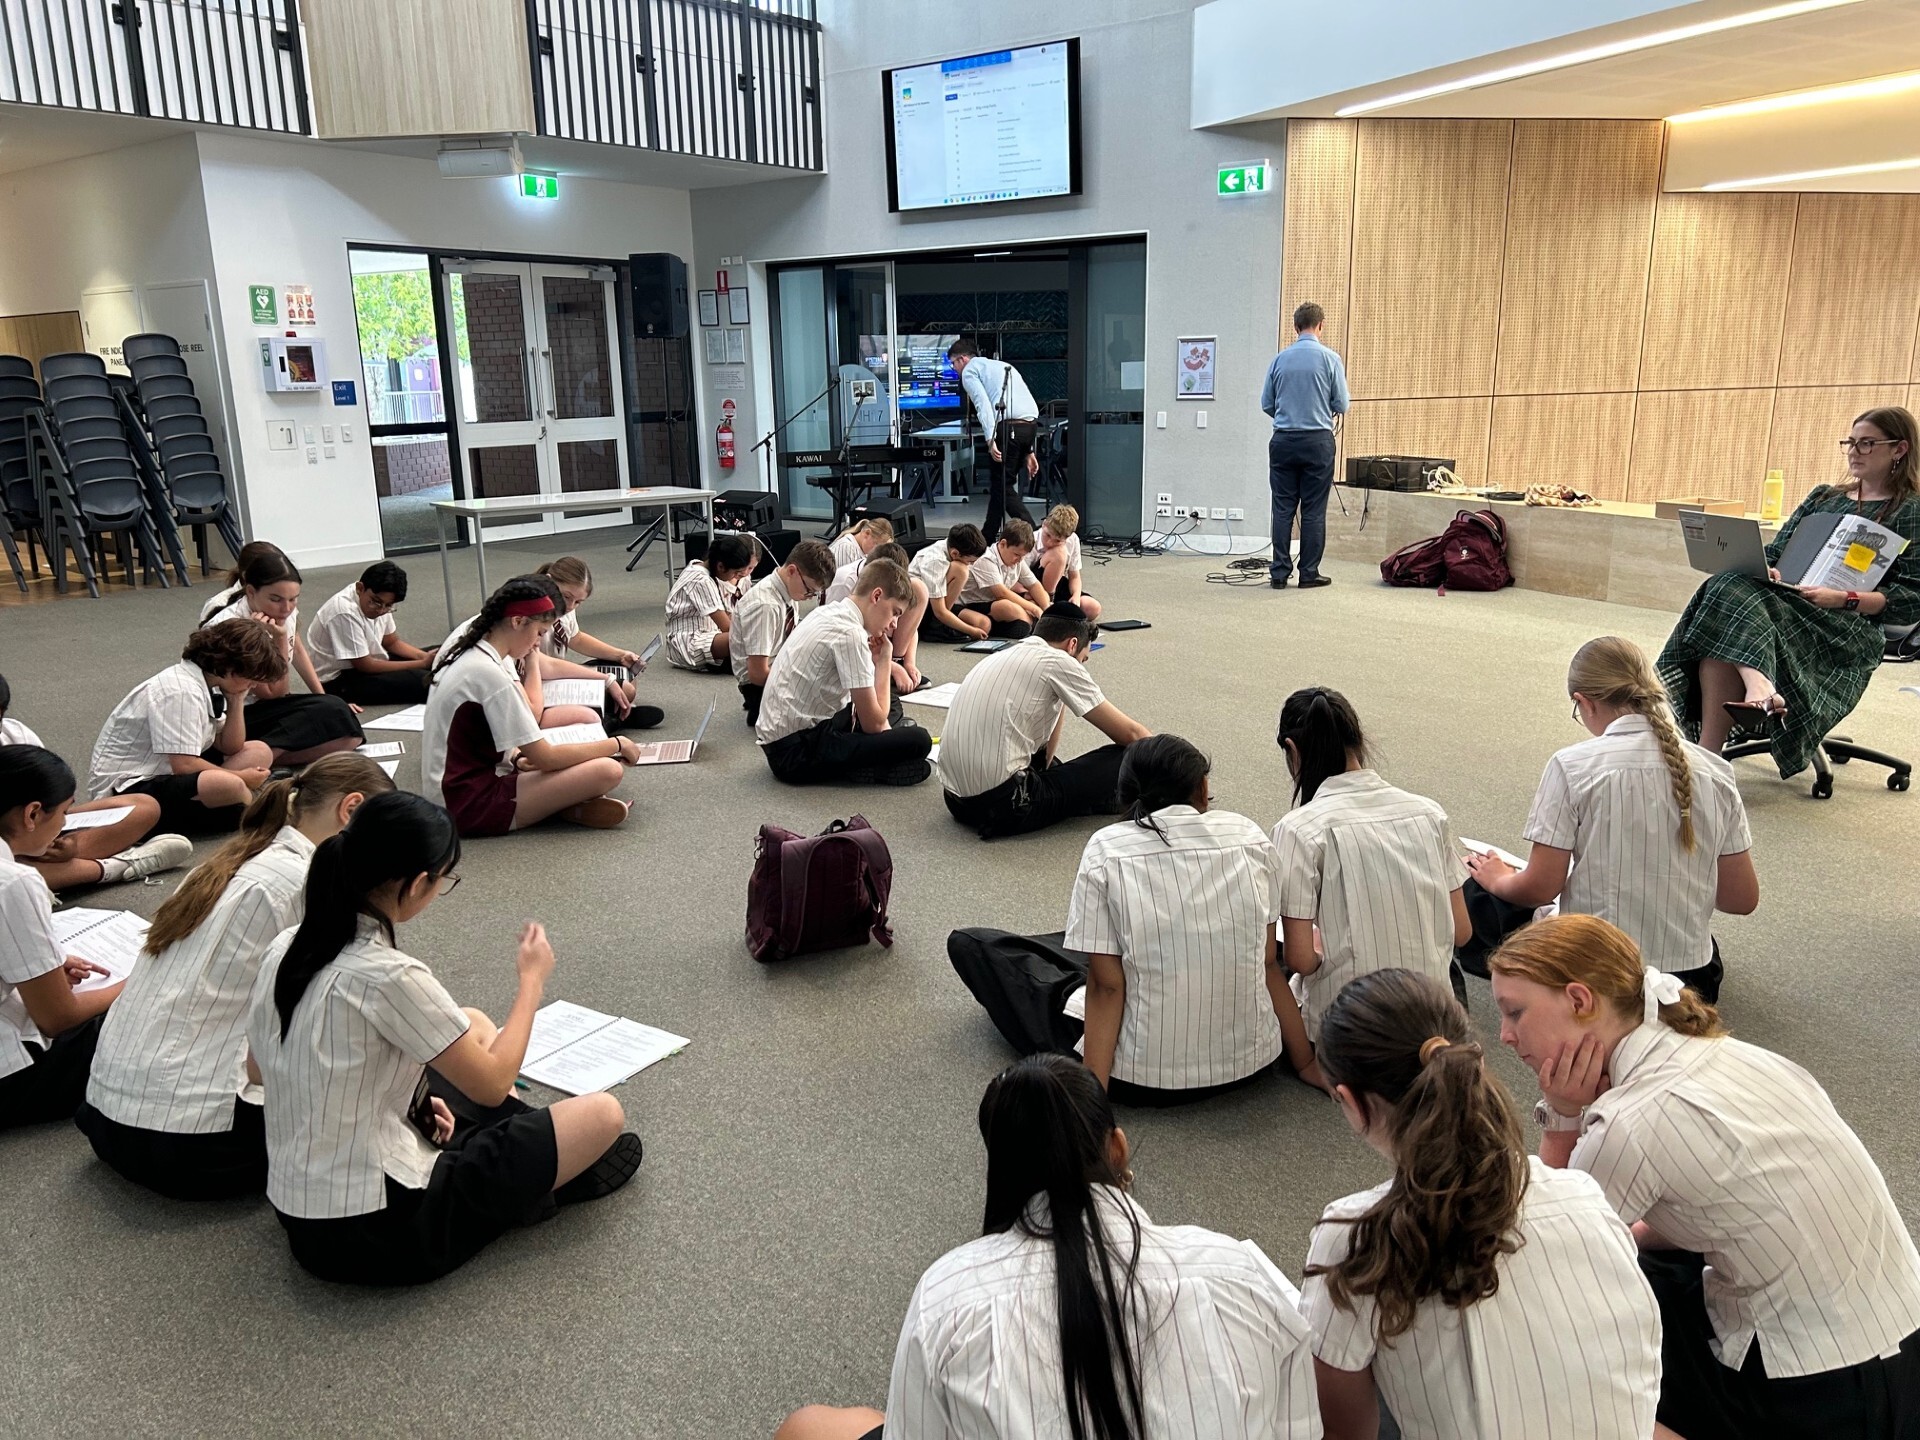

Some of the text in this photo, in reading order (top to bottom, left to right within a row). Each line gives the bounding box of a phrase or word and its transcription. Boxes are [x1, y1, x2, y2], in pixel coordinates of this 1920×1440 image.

[256, 288, 269, 296] AED
[191, 344, 204, 352] REEL
[795, 454, 822, 463] KAWAI
